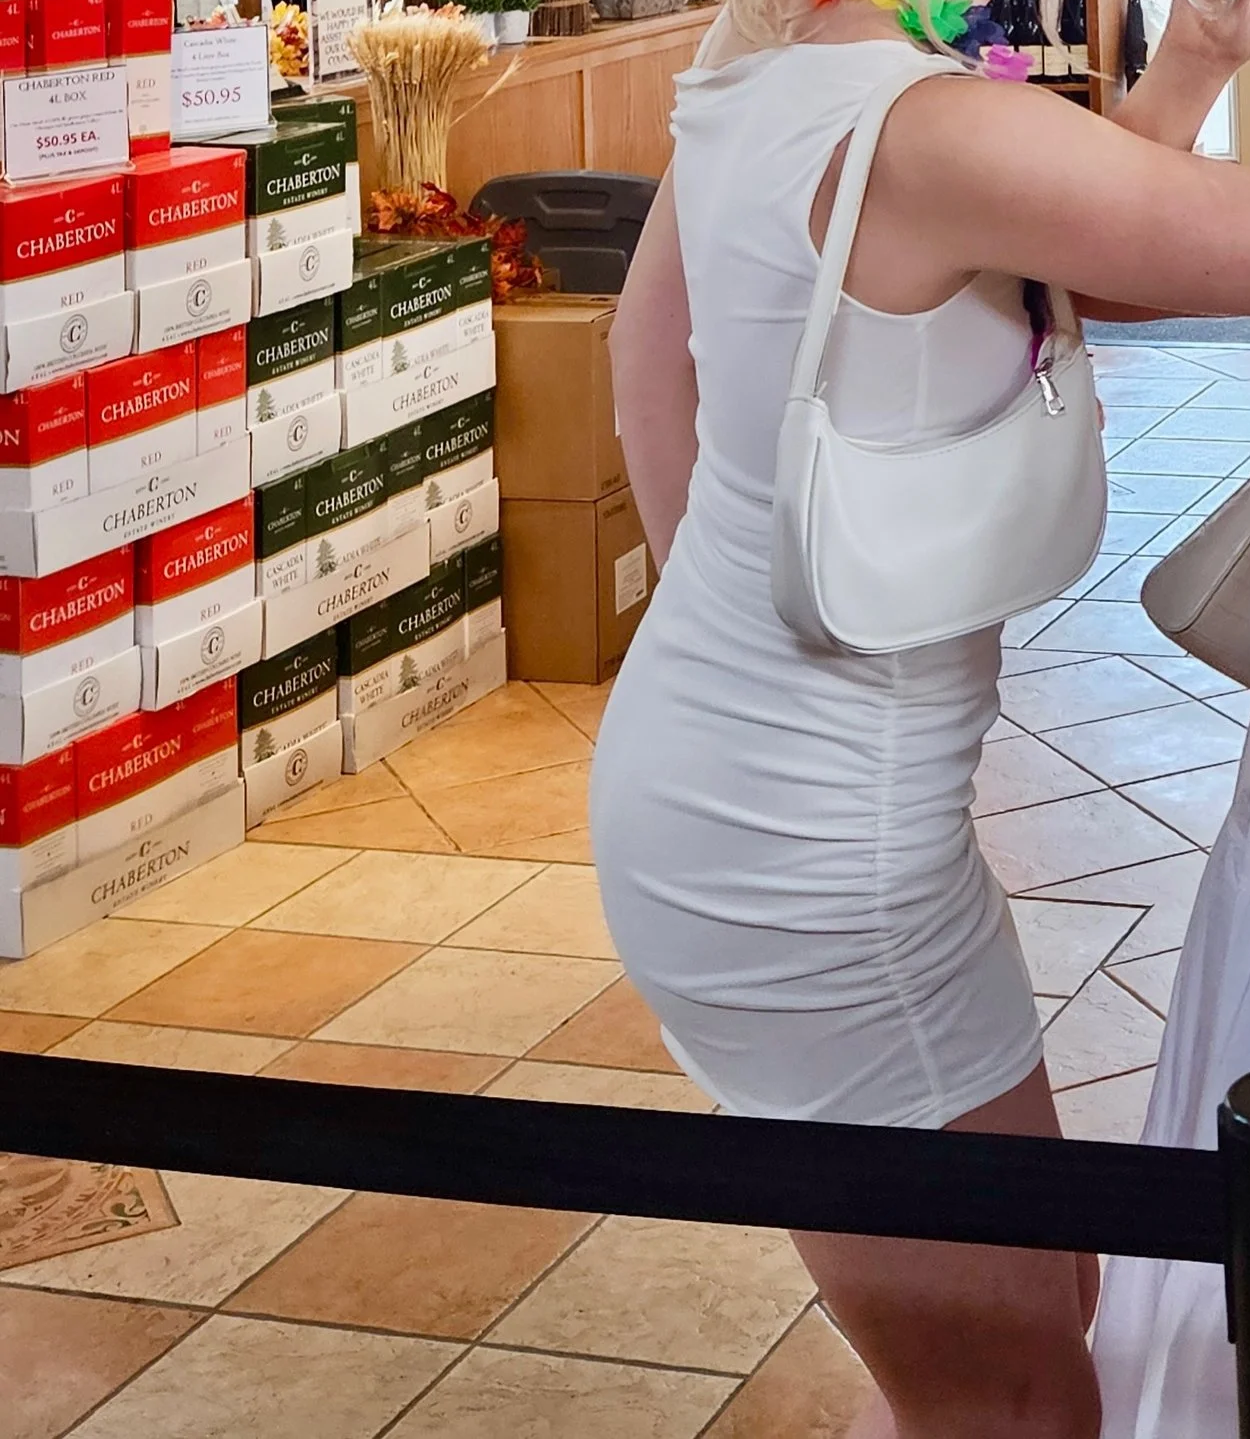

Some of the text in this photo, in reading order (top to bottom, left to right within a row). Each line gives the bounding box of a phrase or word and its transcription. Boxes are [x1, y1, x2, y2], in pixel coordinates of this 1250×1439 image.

[7, 3, 19, 15] 4L
[127, 17, 169, 28] CHABERTON
[52, 25, 101, 40] CHABERTON
[19, 72, 115, 91] CHABERTON RED
[136, 78, 156, 89] RED
[49, 91, 87, 104] 4L BOX
[182, 86, 241, 108] $50.95
[339, 105, 354, 115] 4L
[36, 130, 100, 150] $50.95 EA.
[336, 131, 345, 141] 4L
[302, 153, 310, 166] C
[192, 181, 201, 193] C
[267, 163, 341, 195] CHABERTON
[110, 182, 122, 195] 4L
[283, 187, 328, 205] ESTATE WINERY
[65, 209, 76, 223] C
[149, 190, 238, 226] CHABERTON
[17, 219, 116, 259] CHABERTON
[186, 258, 207, 273] RED
[419, 277, 427, 289] C
[459, 269, 488, 286] CHABERTON
[61, 291, 85, 308] RED
[390, 284, 452, 319] CHABERTON
[345, 308, 378, 326] CHABERTON
[290, 320, 299, 333] C
[256, 328, 329, 366] CHABERTON
[143, 372, 152, 386] C
[203, 362, 242, 380] CHABERTON
[424, 365, 432, 379] C
[101, 378, 191, 423] CHABERTON
[392, 372, 459, 412] CHABERTON
[37, 410, 85, 433] CHABERTON
[457, 417, 465, 428] C
[213, 425, 232, 439] RED
[425, 421, 489, 461] CHABERTON
[141, 451, 162, 469] RED
[149, 476, 159, 492] C
[350, 469, 357, 482] C
[52, 478, 74, 496] RED
[315, 474, 384, 517] CHABERTON
[103, 482, 197, 533] CHABERTON
[267, 509, 302, 531] CHABERTON
[205, 526, 213, 541] C
[164, 530, 249, 579] CHABERTON
[266, 553, 303, 579] CASCADIA
[354, 564, 362, 578] C
[78, 576, 89, 591] C
[272, 569, 298, 589] WHITE
[318, 567, 390, 616] CHABERTON
[432, 586, 439, 599] C
[30, 579, 125, 632] CHABERTON
[200, 603, 221, 622] RED
[398, 589, 461, 635] CHABERTON
[71, 656, 94, 675] RED
[294, 656, 302, 669] C
[253, 658, 331, 707] CHABERTON
[354, 668, 389, 695] CASCADIA
[436, 677, 445, 691] C
[359, 685, 384, 704] WHITE
[401, 678, 469, 728] CHABERTON
[132, 734, 142, 749] C
[88, 734, 182, 793] CHABERTON
[130, 813, 152, 832] RED
[140, 840, 151, 858] C
[91, 840, 190, 905] CHABERTON
